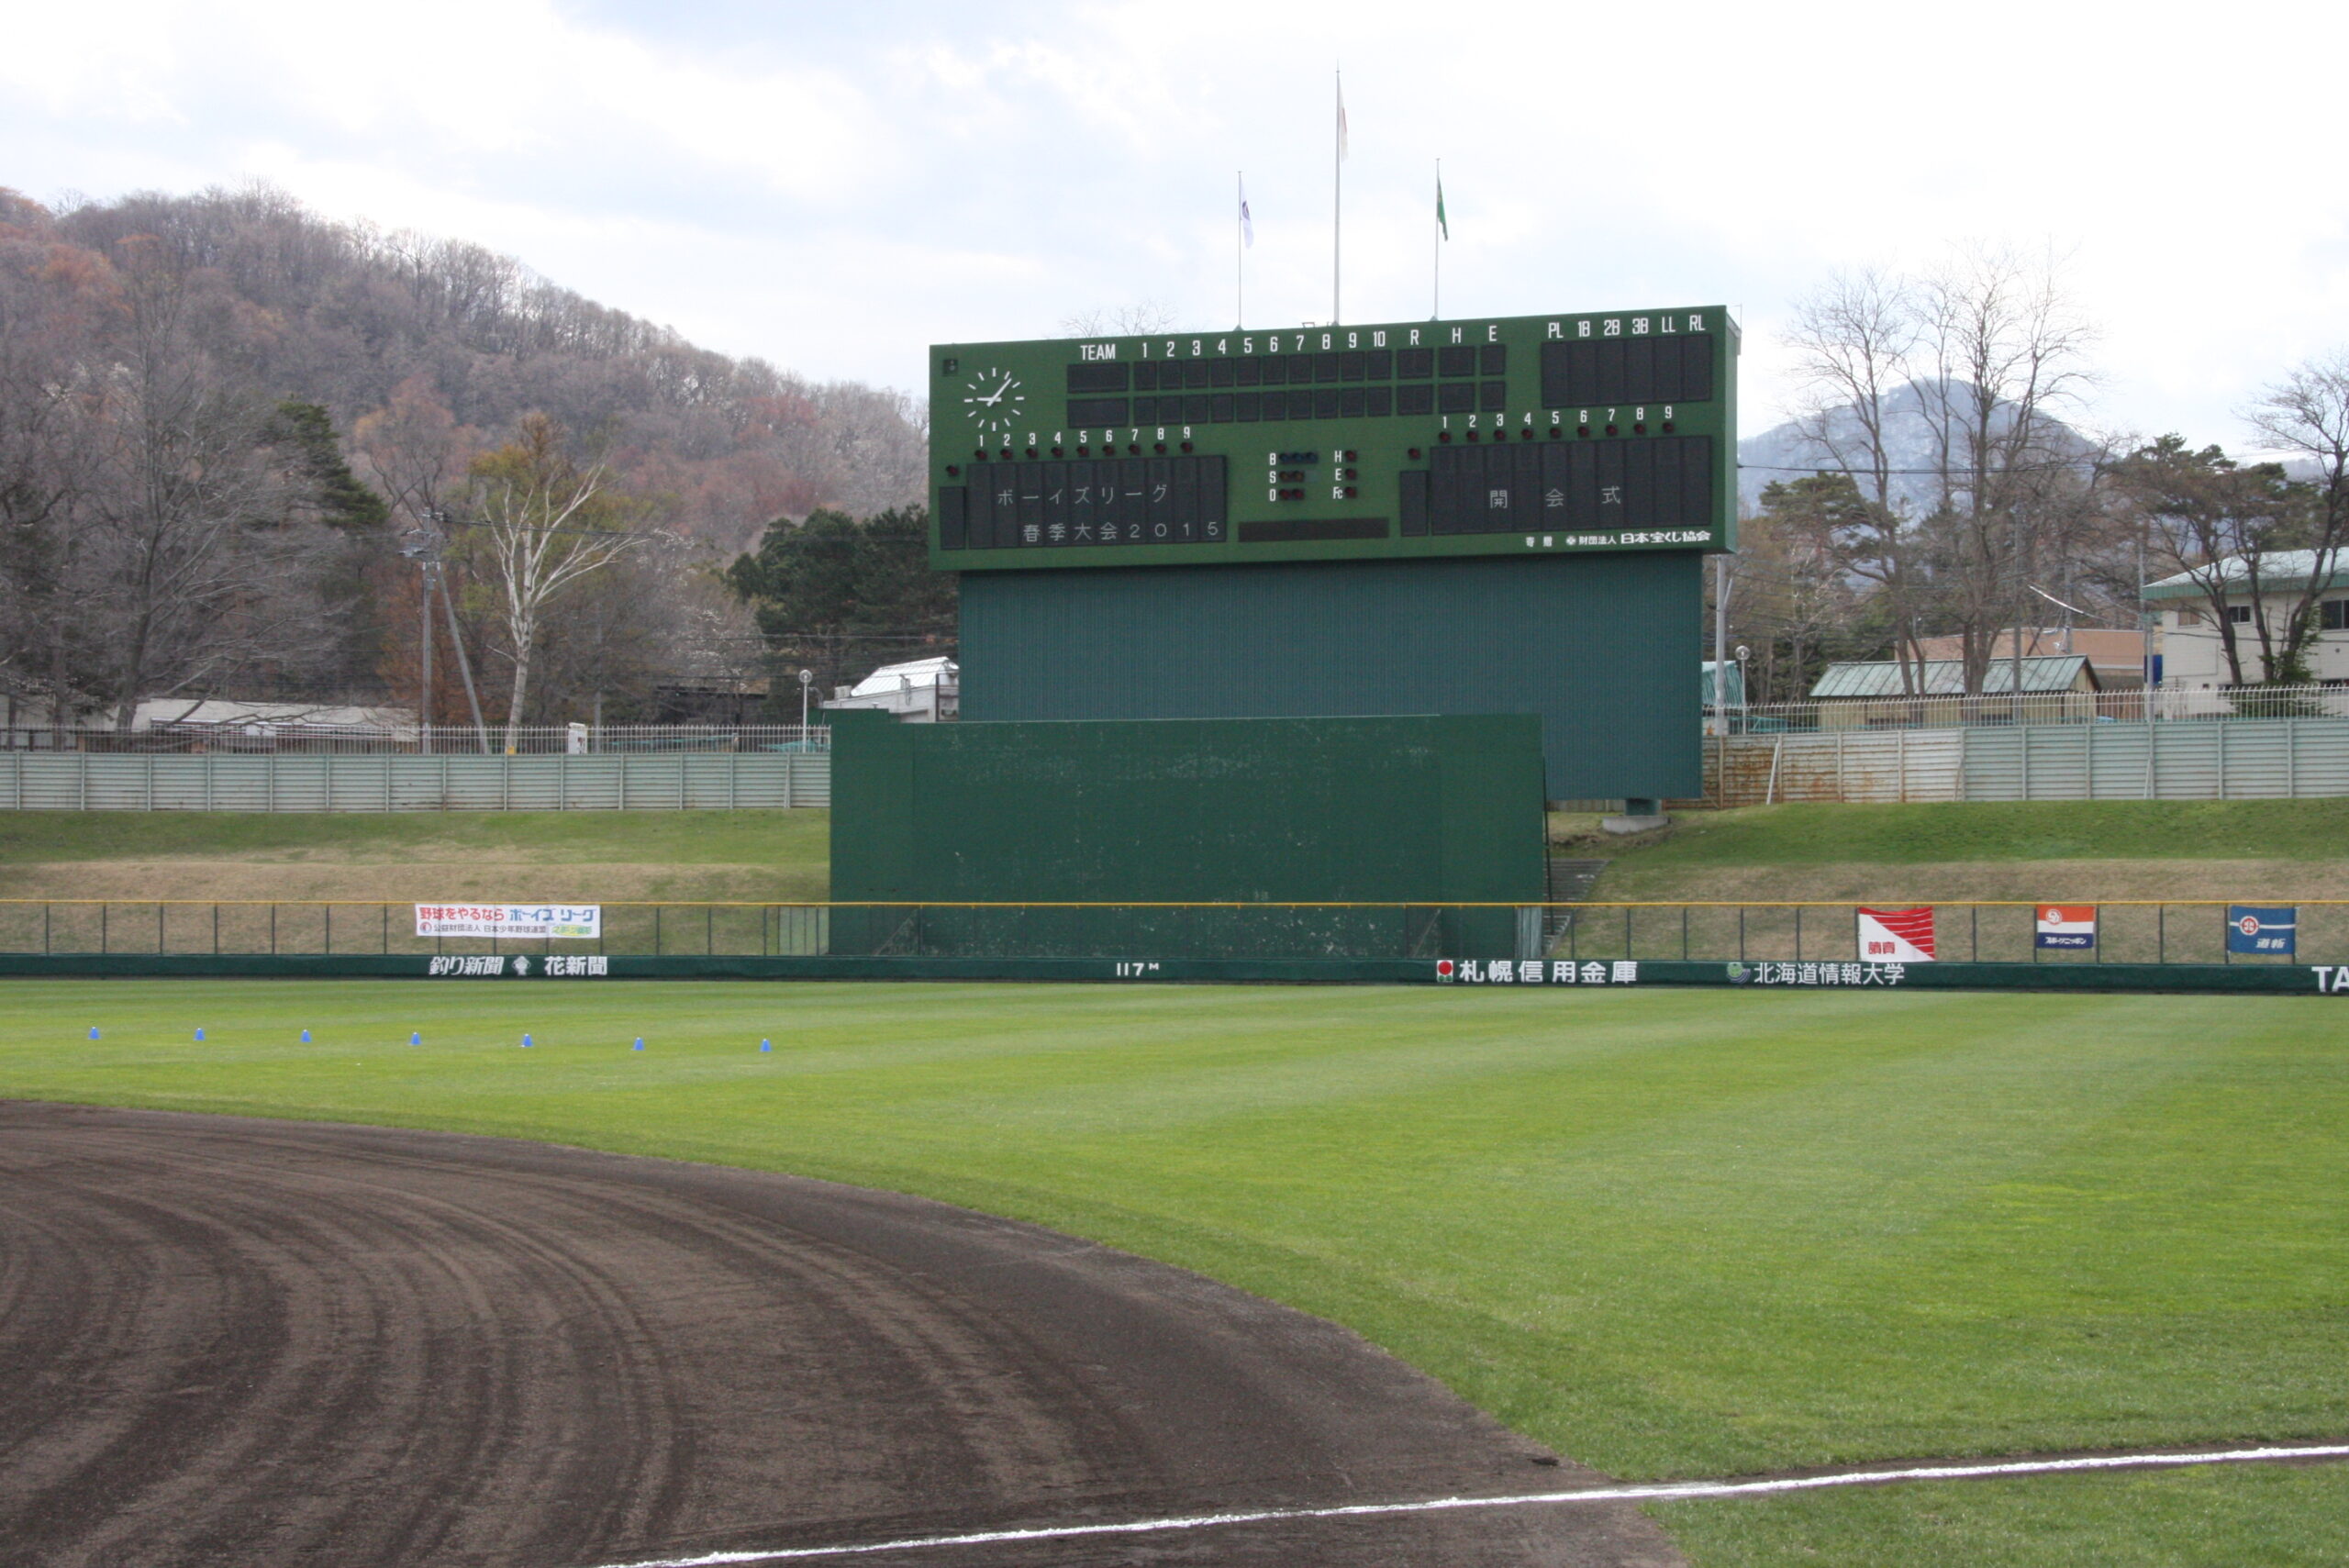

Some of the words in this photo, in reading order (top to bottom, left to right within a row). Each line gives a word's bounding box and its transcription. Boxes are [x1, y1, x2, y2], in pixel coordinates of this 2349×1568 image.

[1548, 321, 1564, 339] PL
[1577, 320, 1591, 338] 1B
[1603, 318, 1620, 337] 2B
[1631, 317, 1649, 335] 3B
[1661, 316, 1676, 333] LL
[1688, 314, 1706, 332] RL
[1079, 343, 1117, 361] TEAM
[1141, 341, 1148, 359] 1
[1166, 340, 1175, 358] 2
[1192, 339, 1201, 356] 3
[1218, 338, 1227, 355] 4
[1243, 337, 1252, 354] 5
[1269, 336, 1279, 353] 6
[1296, 334, 1305, 351] 7
[1321, 333, 1331, 350] 8
[1348, 331, 1357, 349] 9
[1373, 330, 1386, 348] 10
[1409, 328, 1419, 346] R
[1452, 327, 1462, 344] H
[1488, 325, 1497, 342] E
[1442, 416, 1448, 428] 1
[1469, 414, 1476, 428] 2
[1496, 413, 1504, 427] 3
[1523, 412, 1531, 426] 4
[1552, 410, 1560, 425] 5
[1579, 409, 1587, 423] 6
[1608, 408, 1616, 422] 7
[1636, 406, 1644, 420] 8
[1664, 406, 1673, 419] 9
[978, 434, 985, 447] 1
[1003, 433, 1010, 447] 2
[1029, 432, 1036, 446] 3
[1053, 431, 1062, 444] 4
[1079, 430, 1087, 444] 5
[1105, 429, 1113, 442] 6
[1131, 428, 1139, 441] 7
[1157, 427, 1164, 440] 8
[1183, 426, 1191, 439] 9
[1269, 452, 1276, 466] B
[1334, 450, 1342, 463] H
[1269, 470, 1276, 484] S
[1334, 467, 1342, 482] E
[997, 484, 1168, 506] ボーイズリーグ
[1490, 486, 1621, 509] 開会式
[1023, 521, 1219, 543] 春季大会2015
[419, 906, 505, 921] 野球をやるなら
[429, 955, 505, 975] 釣り新聞
[544, 955, 608, 975] 花新聞
[1459, 960, 1638, 984] 札幌信用金庫
[1753, 963, 1905, 985] 北海道情報大学
